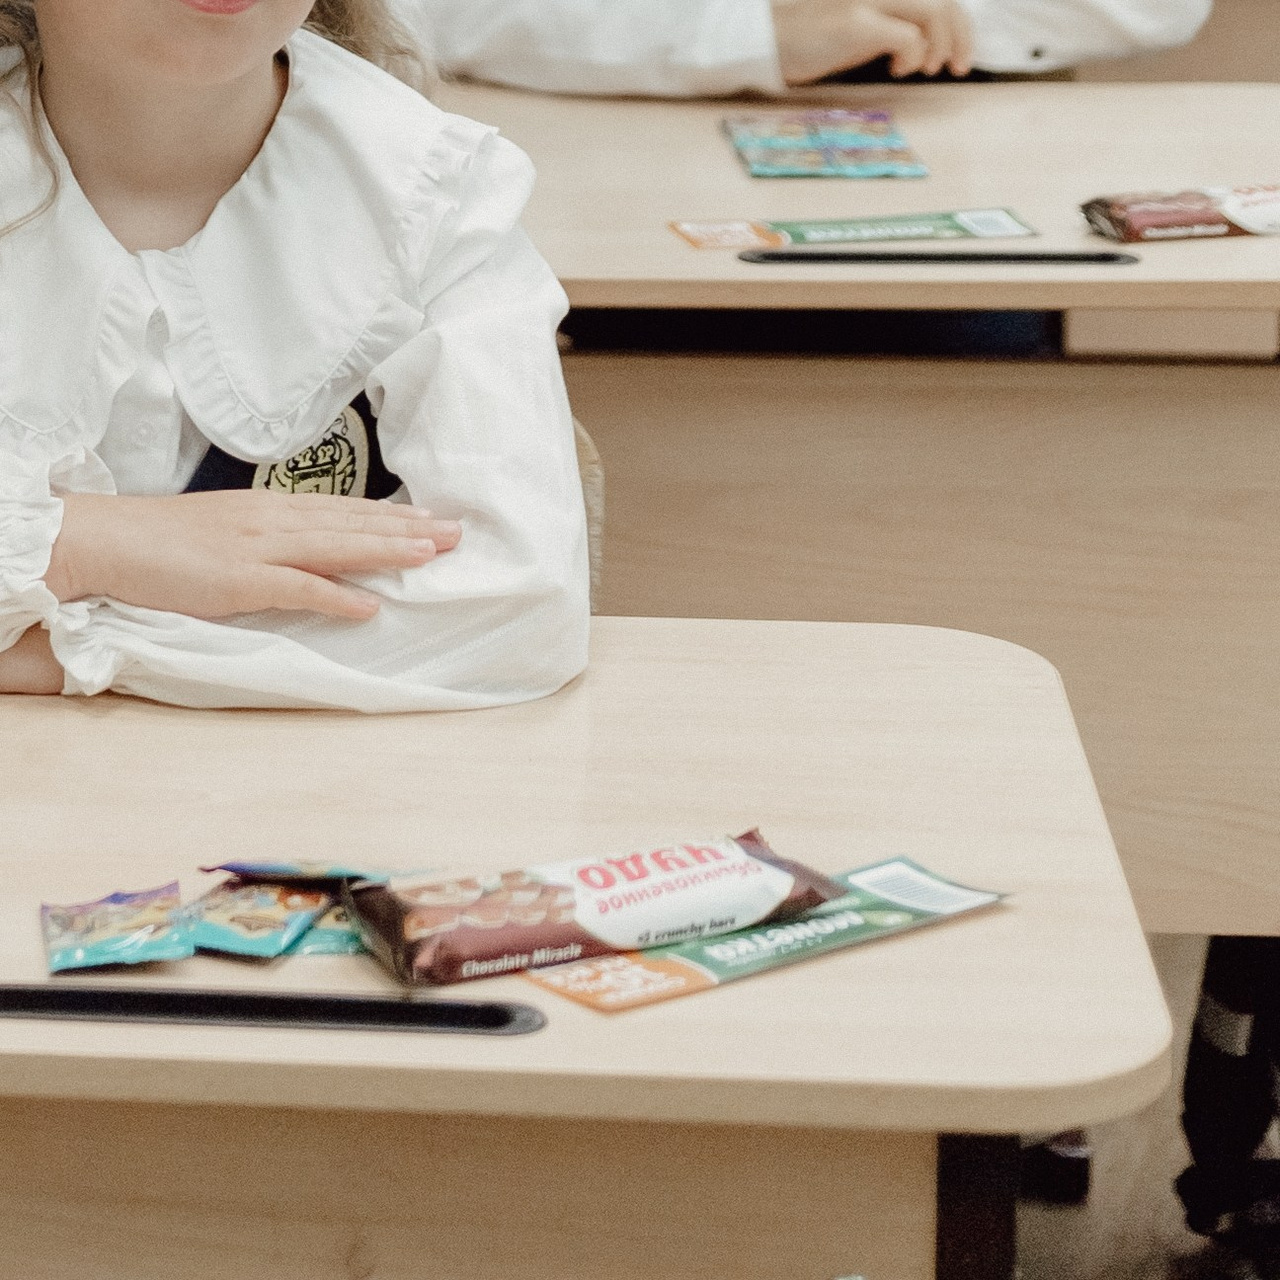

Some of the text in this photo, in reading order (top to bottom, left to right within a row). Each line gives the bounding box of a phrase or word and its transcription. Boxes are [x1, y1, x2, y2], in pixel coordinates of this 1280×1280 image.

[577, 843, 727, 889] ЧУДО
[462, 942, 582, 977] Chocolate Miracle
